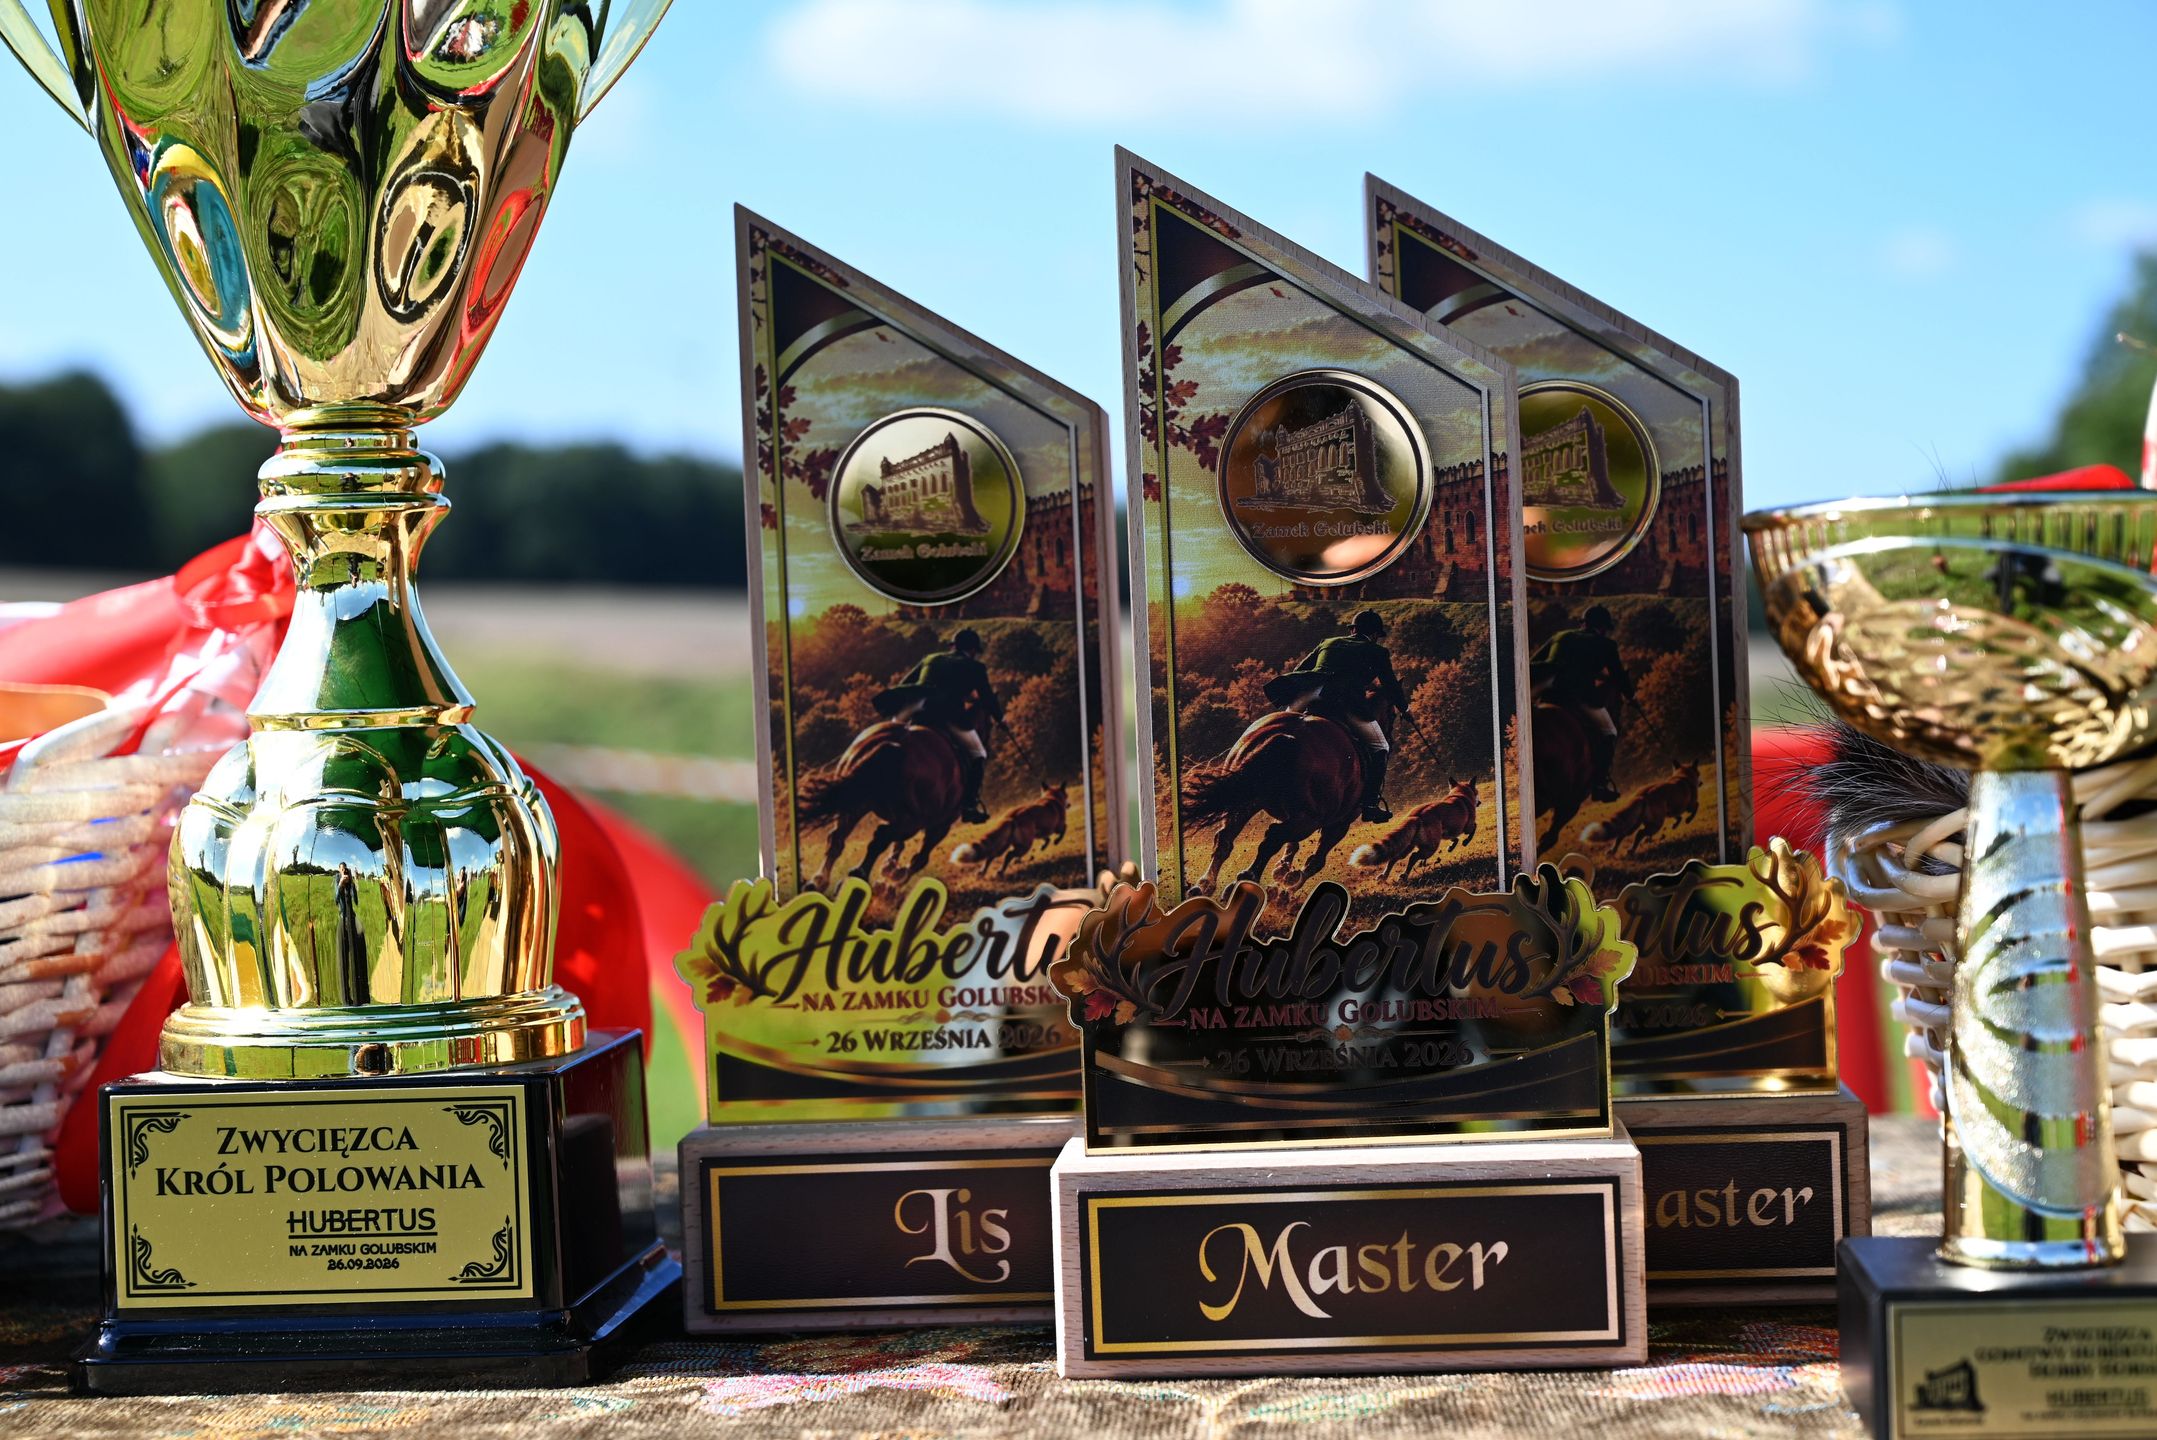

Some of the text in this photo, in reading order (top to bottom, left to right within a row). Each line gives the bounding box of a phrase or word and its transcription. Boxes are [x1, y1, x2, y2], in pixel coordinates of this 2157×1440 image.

[1252, 519, 1391, 538] Zamek Golubski
[760, 887, 1094, 1004] Hubertu
[1148, 892, 1551, 1022] Hubertus
[802, 985, 1067, 1012] NA ZAMKU GOLUBSK
[1189, 998, 1501, 1030] NA ZAMKU GOLUBSKIM
[826, 1024, 1062, 1054] 26 WRZEŚNIA 2026
[1216, 1040, 1475, 1074] 26 WRZEŚNIA 2026
[216, 1126, 419, 1158] ZWYCIĘZCA
[155, 1162, 485, 1196] KRÓL POLOWANIA
[1644, 1177, 1814, 1229] aster
[287, 1208, 436, 1233] HUBERTUS
[894, 1188, 1011, 1284] Lis
[289, 1242, 437, 1257] NA ZAMKU GOLUBSKIM
[327, 1257, 400, 1271] 26.09.2026
[1199, 1221, 1509, 1321] Master
